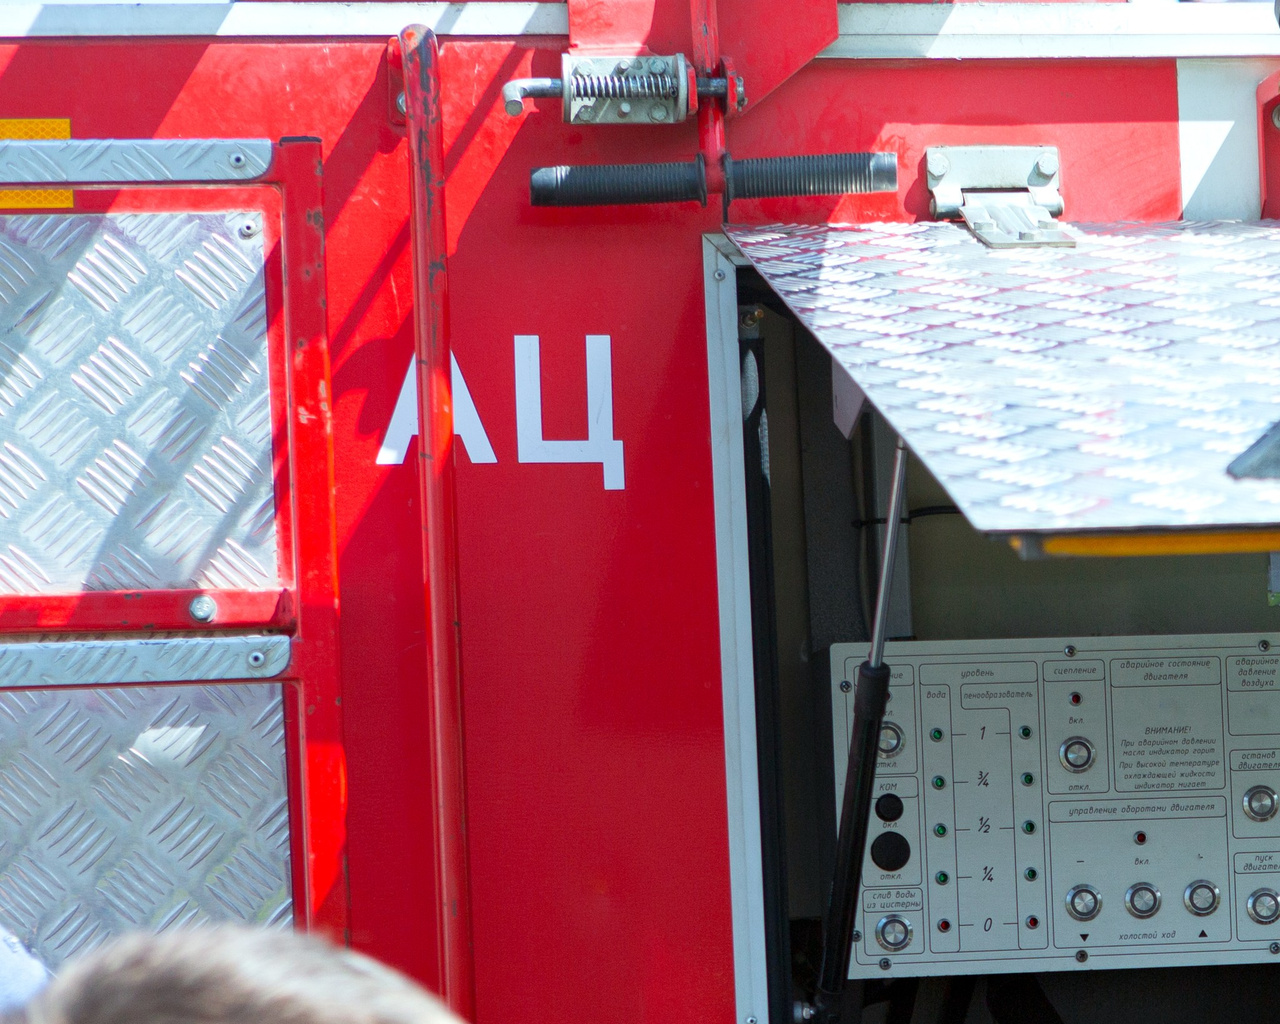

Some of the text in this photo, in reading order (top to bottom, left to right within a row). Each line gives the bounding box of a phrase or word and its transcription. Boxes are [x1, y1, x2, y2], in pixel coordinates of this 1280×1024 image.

[376, 335, 625, 490] АЦ
[1120, 660, 1164, 669] аварийное
[1236, 657, 1279, 666] аварийное
[961, 670, 994, 679] уровень
[1054, 667, 1096, 675] сцепление
[1144, 673, 1188, 681] двигателя
[1241, 679, 1274, 688] воздуха
[927, 691, 946, 699] вода
[964, 691, 1033, 699] пенообразователь
[980, 726, 986, 740] 1
[1145, 727, 1192, 735] ВНИМАНИЕ!
[1121, 740, 1135, 748] При
[1138, 738, 1178, 747] аварийном
[1149, 748, 1189, 756] индикатор
[1242, 751, 1276, 759] останов
[1137, 760, 1167, 768] высокой
[1169, 760, 1220, 768] температуре
[1124, 770, 1215, 780] охлаждающей жидкости
[1134, 782, 1175, 790] индикатор
[1069, 804, 1215, 816] управление оборотами двигателя
[1255, 855, 1273, 863] пуск
[873, 891, 915, 899] слив воды
[881, 901, 921, 909] цистерны
[984, 918, 992, 932] 0
[1119, 930, 1176, 940] холостой ход
